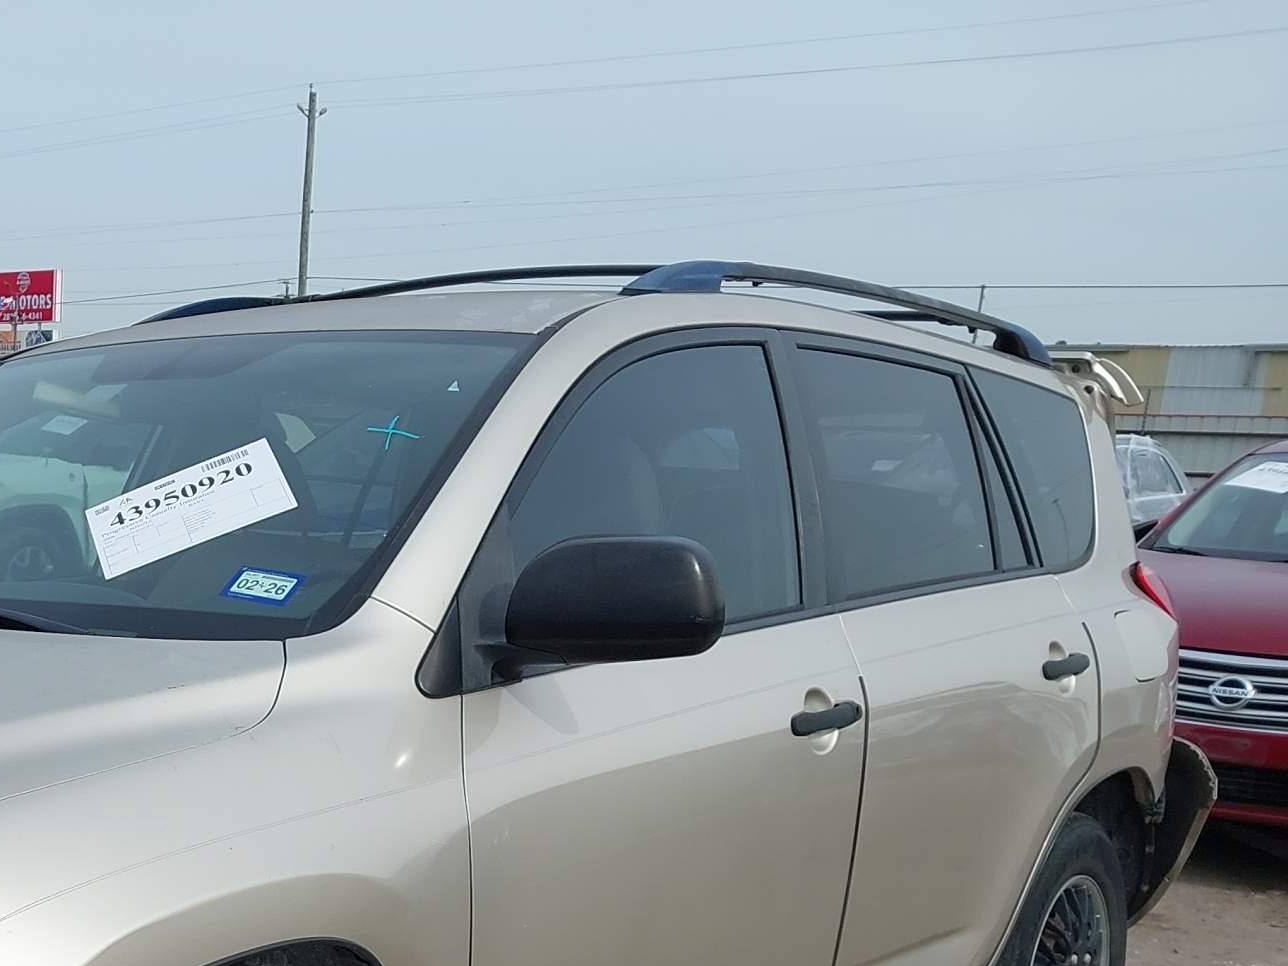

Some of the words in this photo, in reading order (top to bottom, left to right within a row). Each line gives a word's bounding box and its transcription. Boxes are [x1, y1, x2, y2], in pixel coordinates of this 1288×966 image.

[110, 462, 253, 528] 43950920
[236, 578, 259, 591] 02
[263, 582, 288, 596] 26
[1211, 687, 1249, 697] NISSAN
